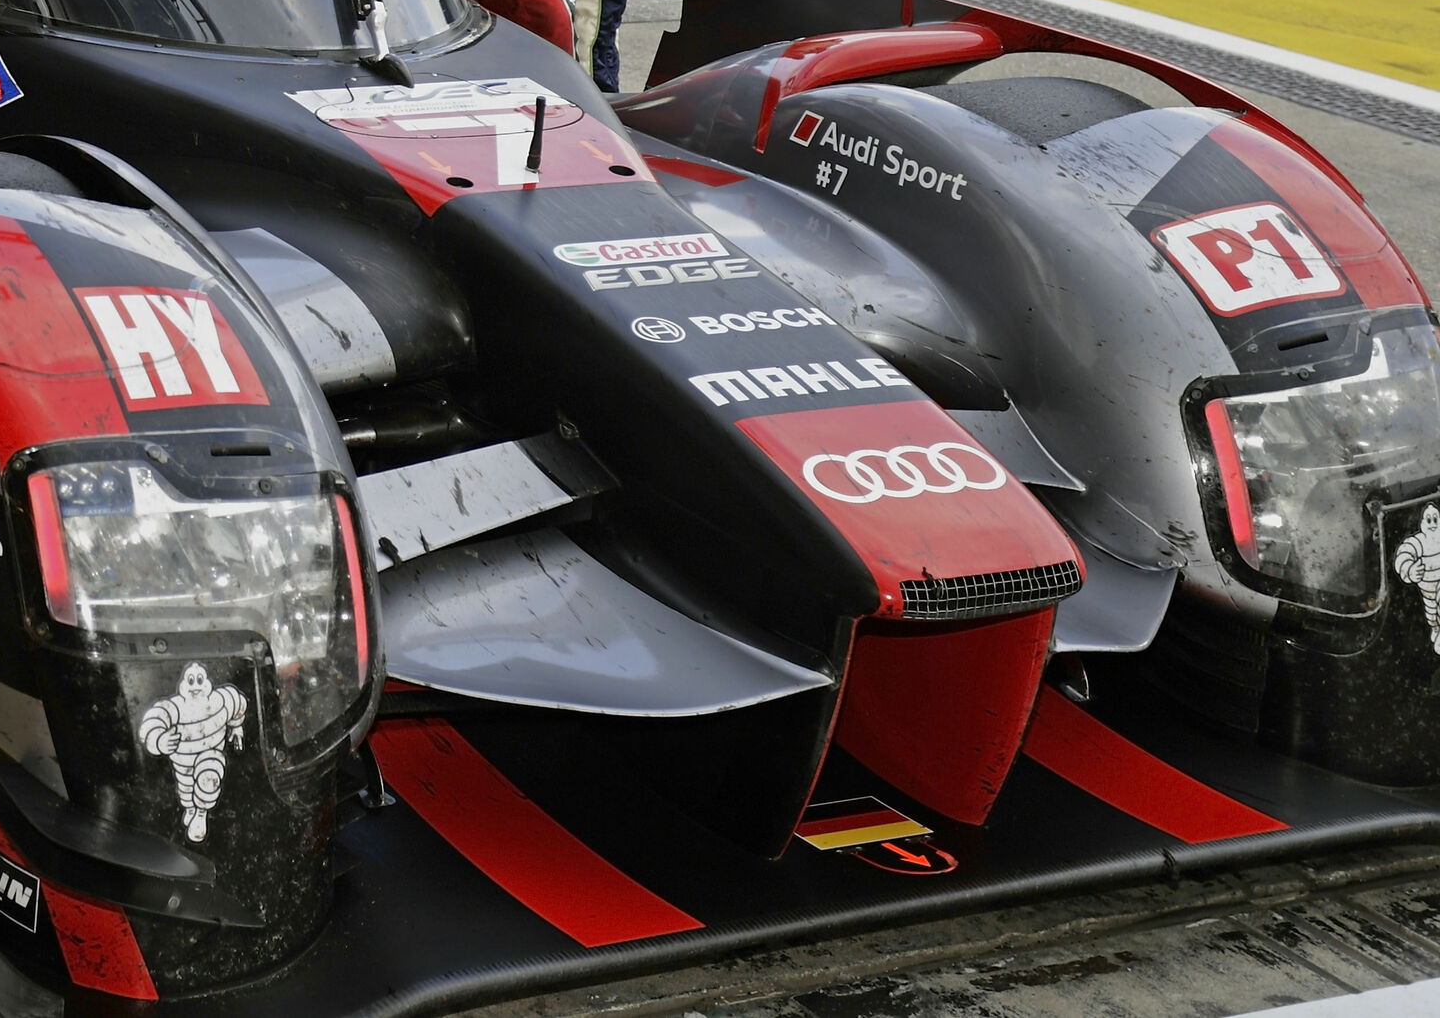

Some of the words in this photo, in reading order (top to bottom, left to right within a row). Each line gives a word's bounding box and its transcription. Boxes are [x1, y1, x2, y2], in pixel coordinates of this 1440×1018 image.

[815, 159, 849, 197] #7
[819, 120, 881, 167] Audi
[882, 144, 968, 202] Sport
[598, 237, 719, 263] Castrol
[1186, 217, 1319, 293] P1
[582, 258, 761, 292] EDGE
[688, 306, 838, 336] BOSCH
[83, 291, 242, 401] HY
[687, 357, 912, 408] MAHLE
